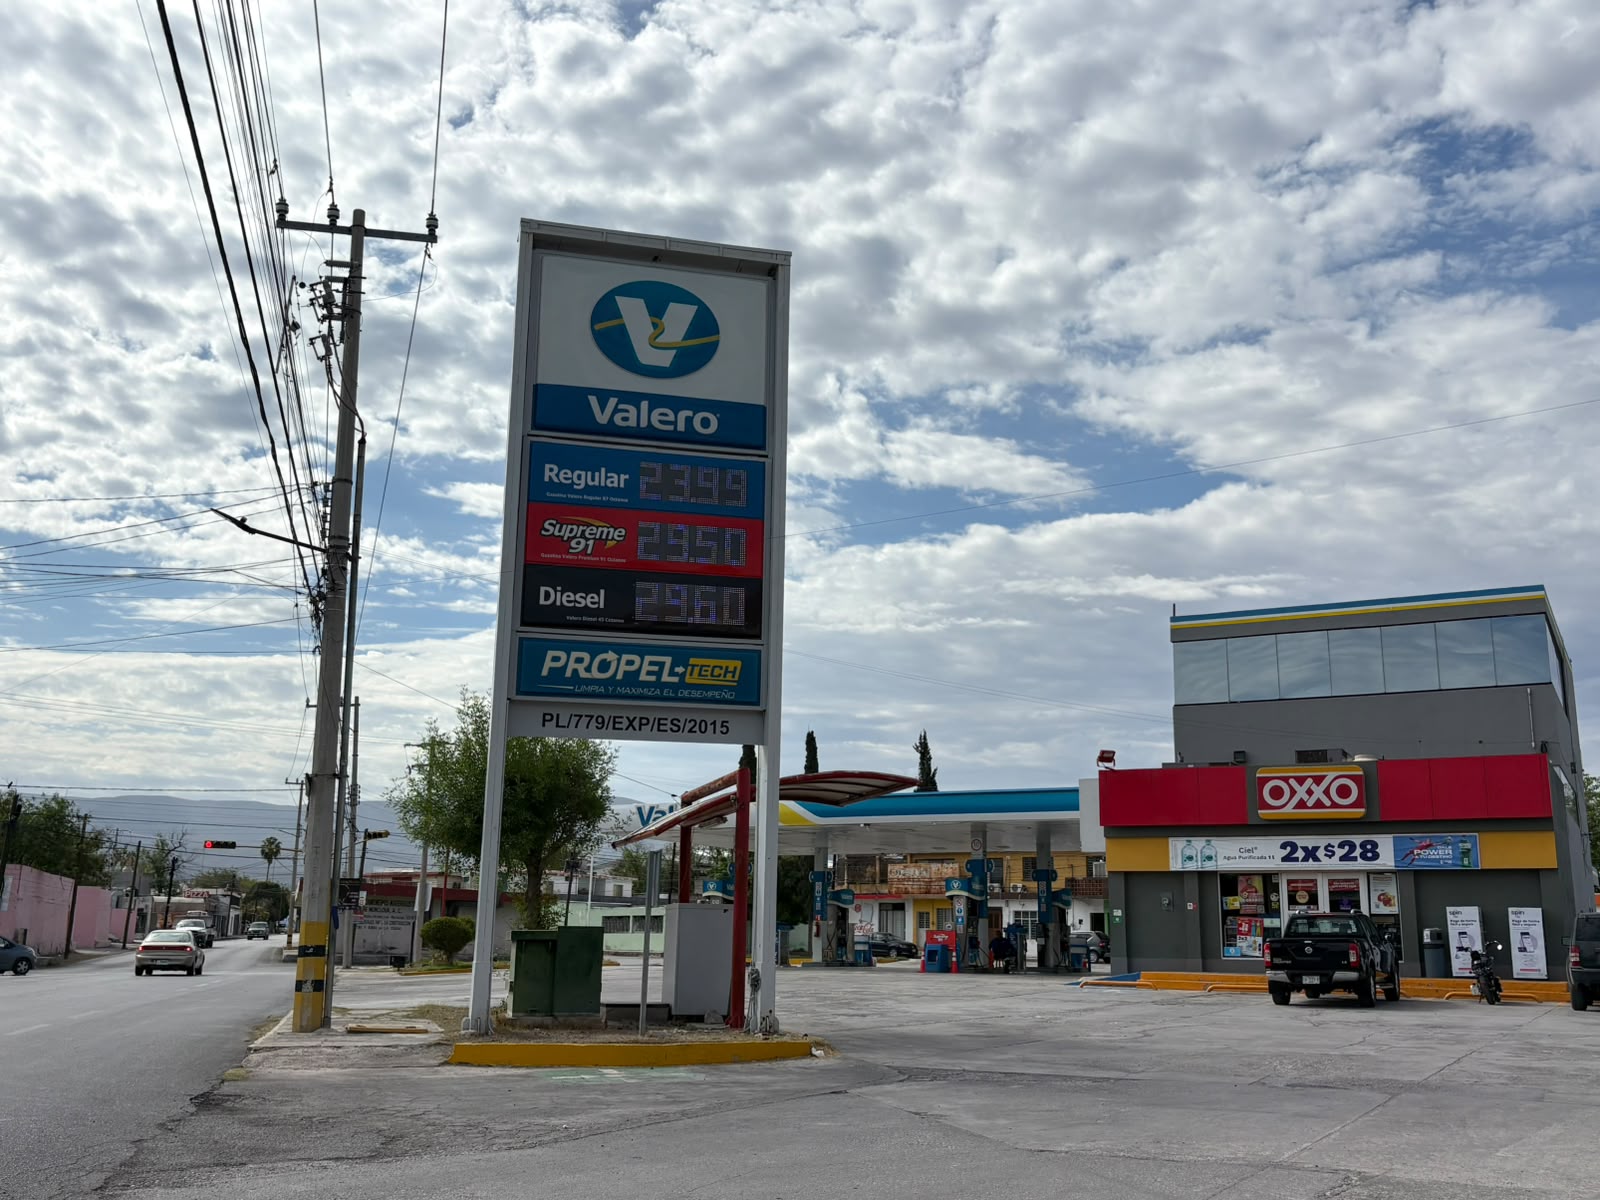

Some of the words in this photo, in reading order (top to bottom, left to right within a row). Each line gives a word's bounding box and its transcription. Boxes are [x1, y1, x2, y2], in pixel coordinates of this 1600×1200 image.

[588, 395, 718, 434] Valero
[544, 464, 629, 490] Regular
[640, 462, 747, 506] 23.99
[541, 520, 626, 540] Supreme
[638, 521, 746, 566] 29.50
[568, 538, 594, 554] 91
[539, 586, 605, 608] Diesel
[635, 582, 745, 626] 29.60
[541, 650, 679, 682] PROPEL
[688, 663, 738, 679] TECH
[616, 687, 662, 696] MAXIMIZA
[678, 689, 736, 699] DESEMPEÑO
[542, 712, 730, 734] PL/779/EXP/ES/2015
[1262, 773, 1359, 812] OXXO
